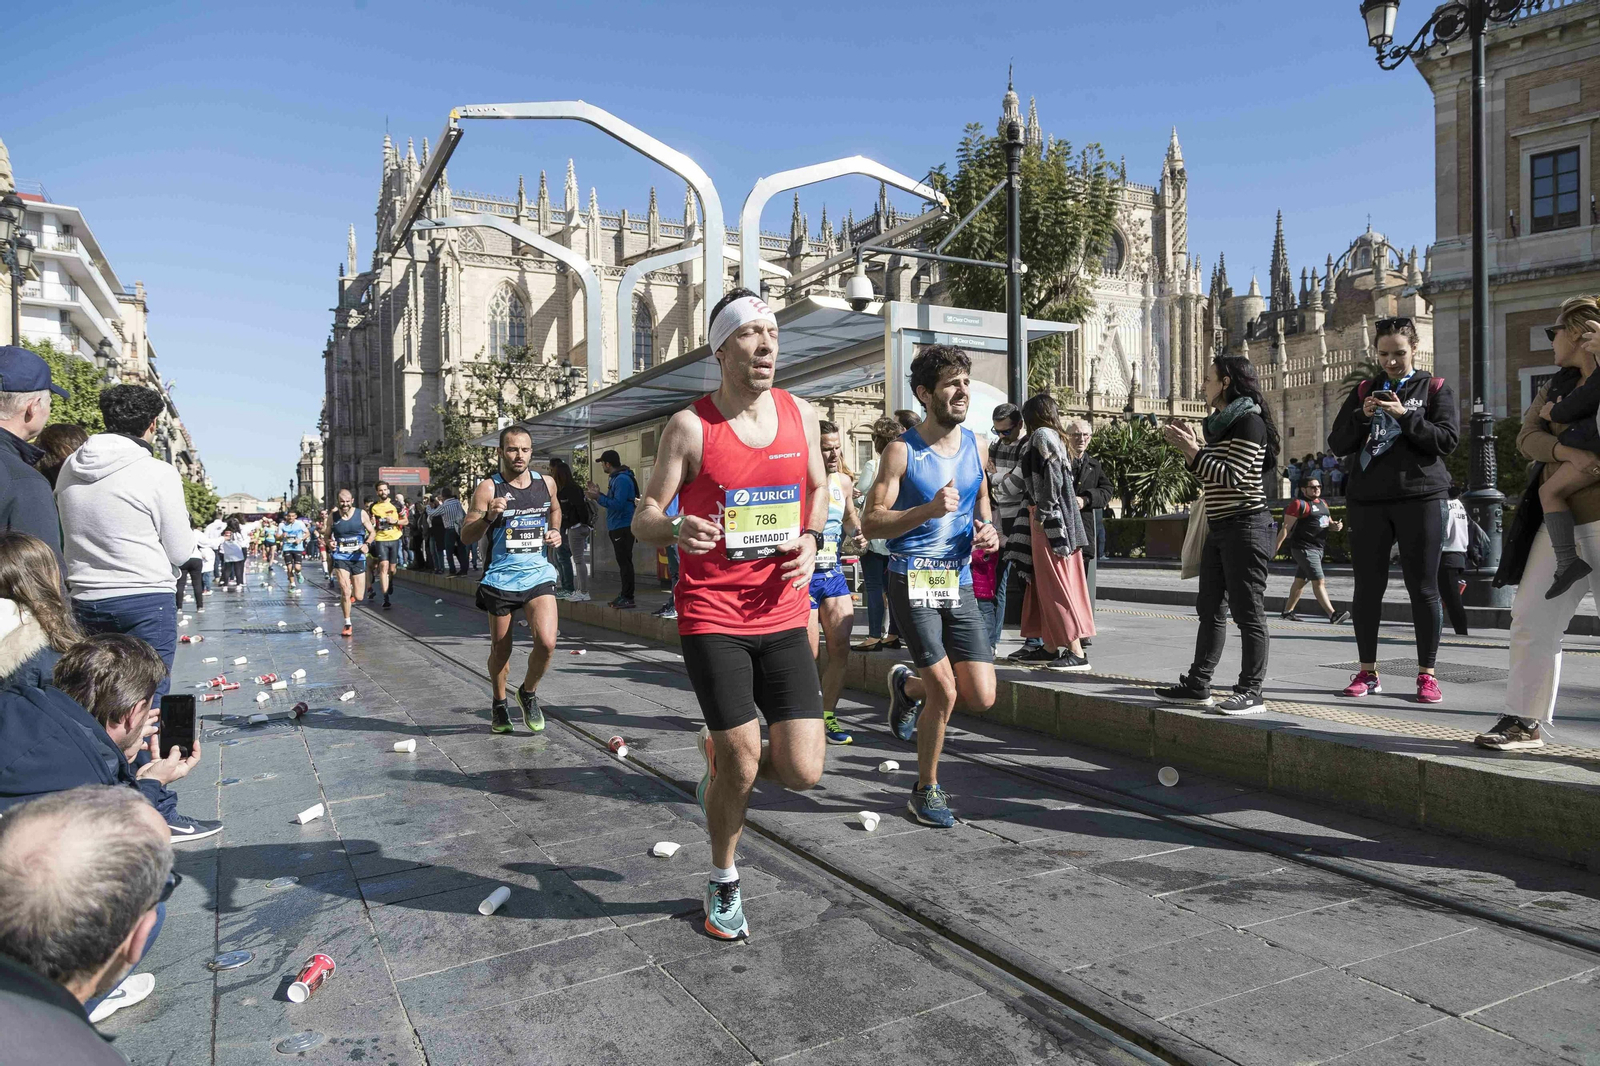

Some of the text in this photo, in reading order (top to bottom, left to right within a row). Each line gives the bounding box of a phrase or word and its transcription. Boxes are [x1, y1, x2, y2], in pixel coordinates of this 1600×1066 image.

[752, 490, 794, 502] ZURICH
[755, 513, 778, 526] 786
[742, 532, 790, 544] CHEMADDT
[928, 576, 946, 585] 856
